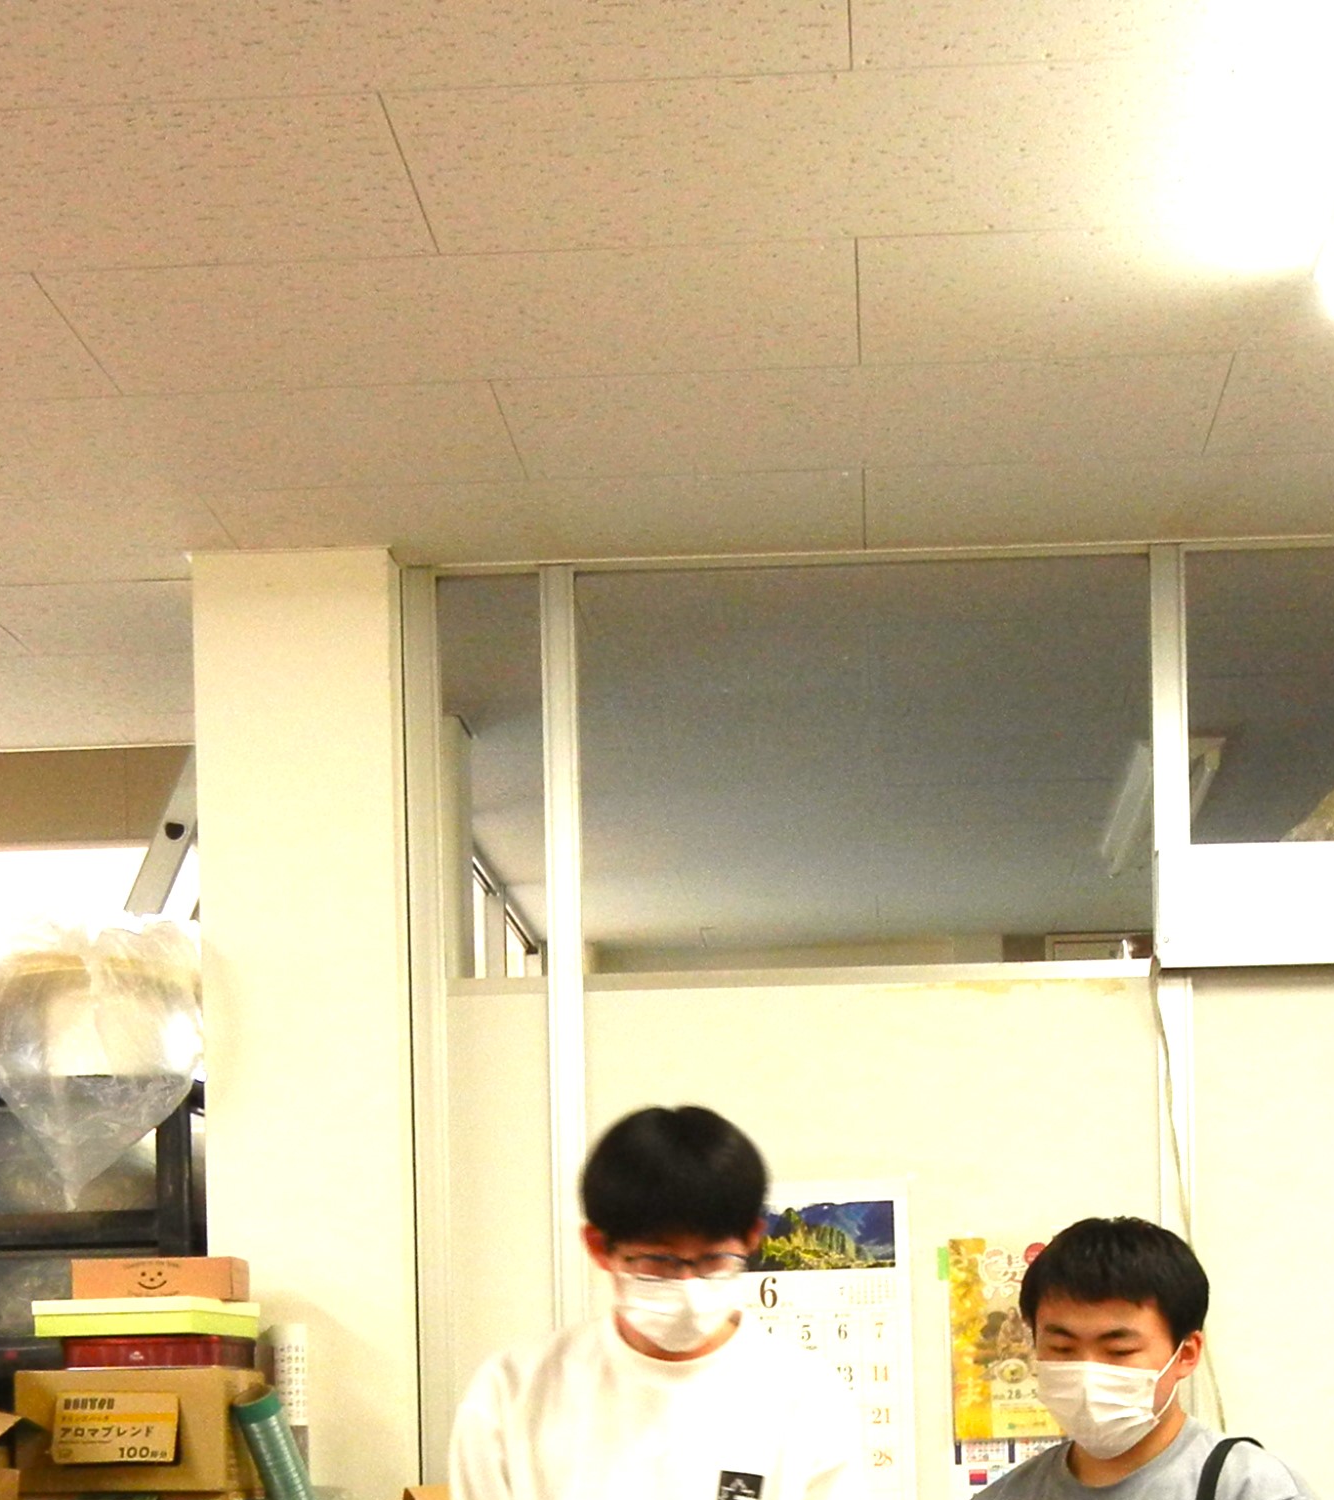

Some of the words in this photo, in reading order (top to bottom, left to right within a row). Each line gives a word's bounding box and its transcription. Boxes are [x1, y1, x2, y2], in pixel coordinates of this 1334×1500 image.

[759, 1275, 778, 1309] 6
[800, 1323, 812, 1342] 5
[837, 1322, 849, 1341] 6
[871, 1407, 891, 1424] 21
[59, 1425, 155, 1438] アロマブレンド
